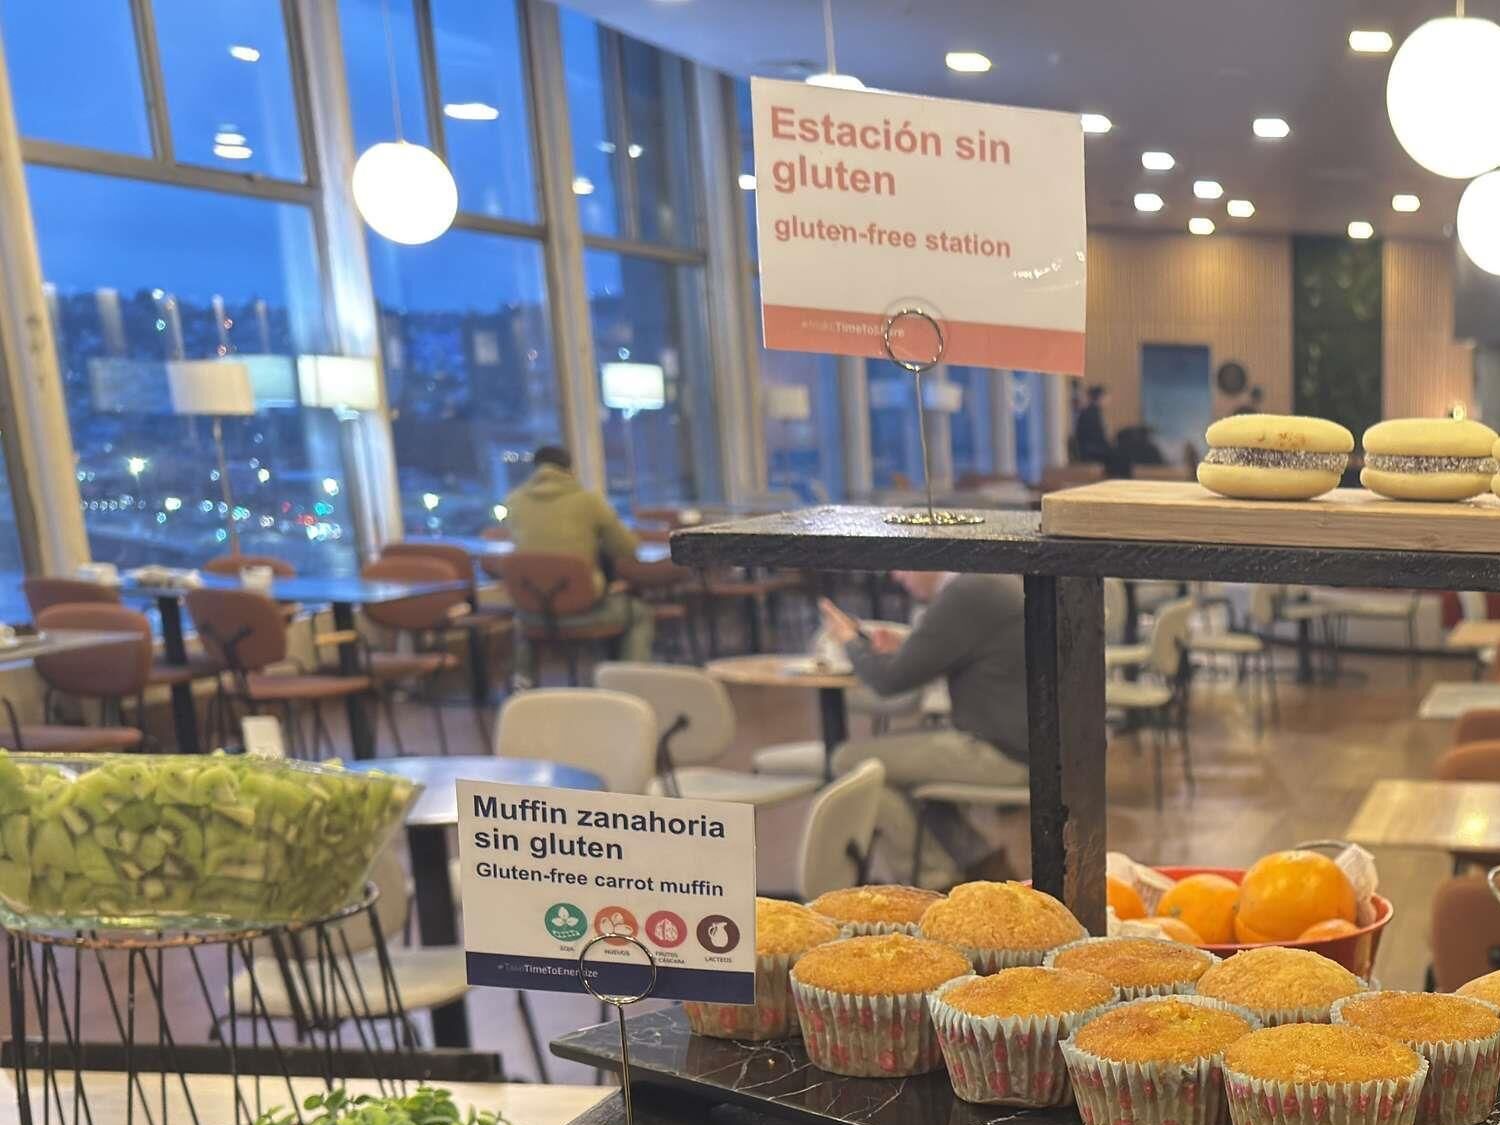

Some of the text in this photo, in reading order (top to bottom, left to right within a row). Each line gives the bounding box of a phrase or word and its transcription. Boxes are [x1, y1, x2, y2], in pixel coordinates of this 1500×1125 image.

[771, 105, 1011, 164] Estación sin
[772, 155, 896, 196] gluten
[774, 216, 1011, 258] gluten-free station
[473, 794, 725, 838] Muffin zanahoria
[474, 828, 623, 860] sin gluten
[476, 862, 723, 896] Gluten-free carrot muffin
